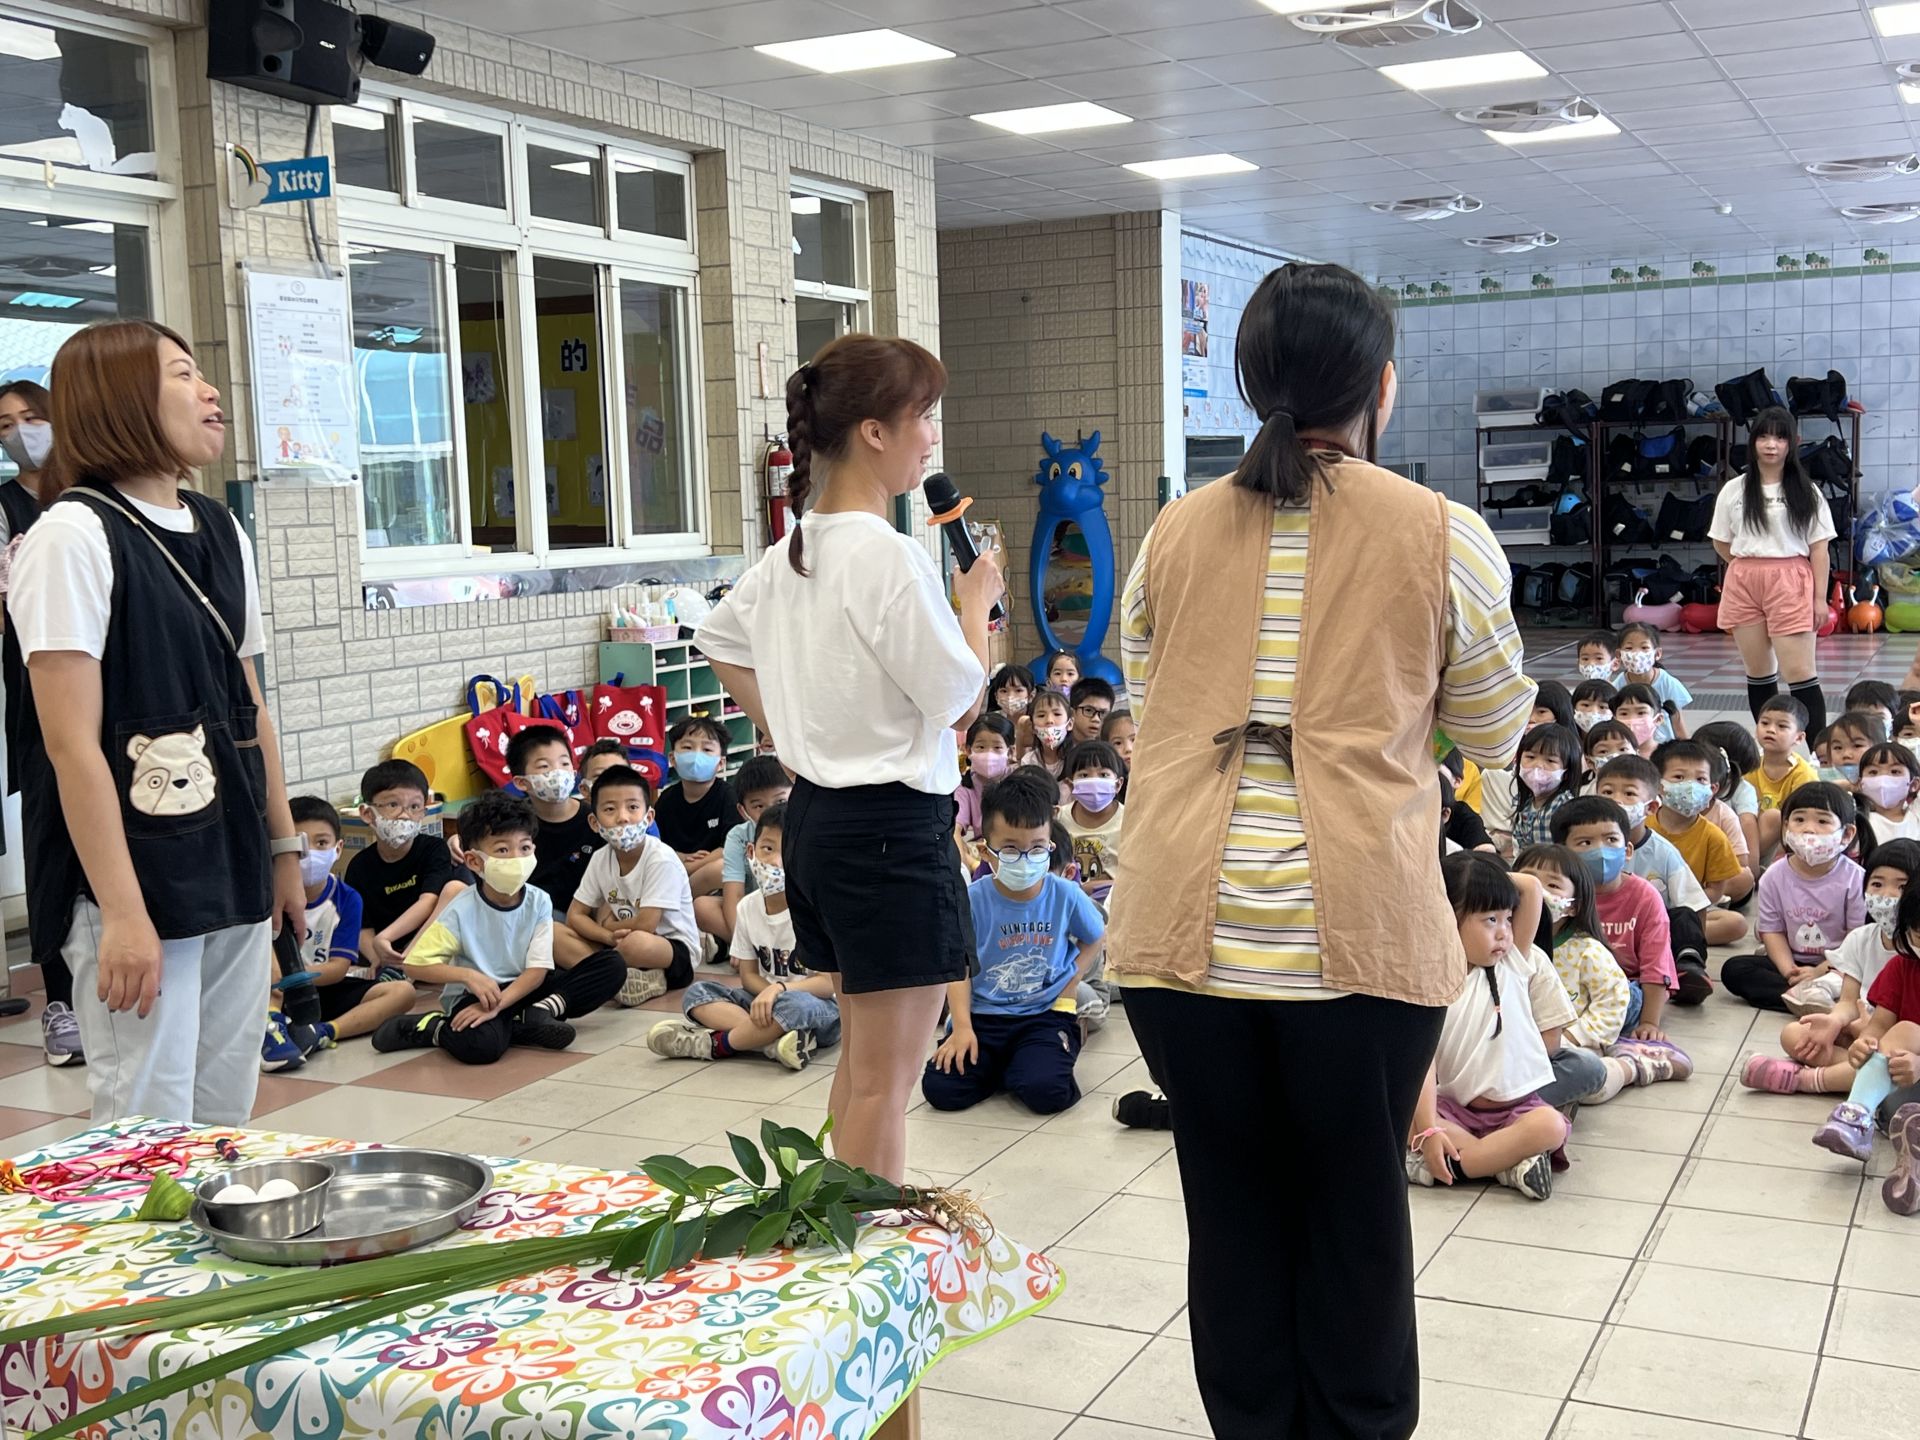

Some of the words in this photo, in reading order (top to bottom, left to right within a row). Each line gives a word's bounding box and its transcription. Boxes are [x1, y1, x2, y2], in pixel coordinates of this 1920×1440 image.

[277, 169, 324, 194] Kitty
[560, 338, 588, 372] 的
[1000, 922, 1052, 936] VINTAGE
